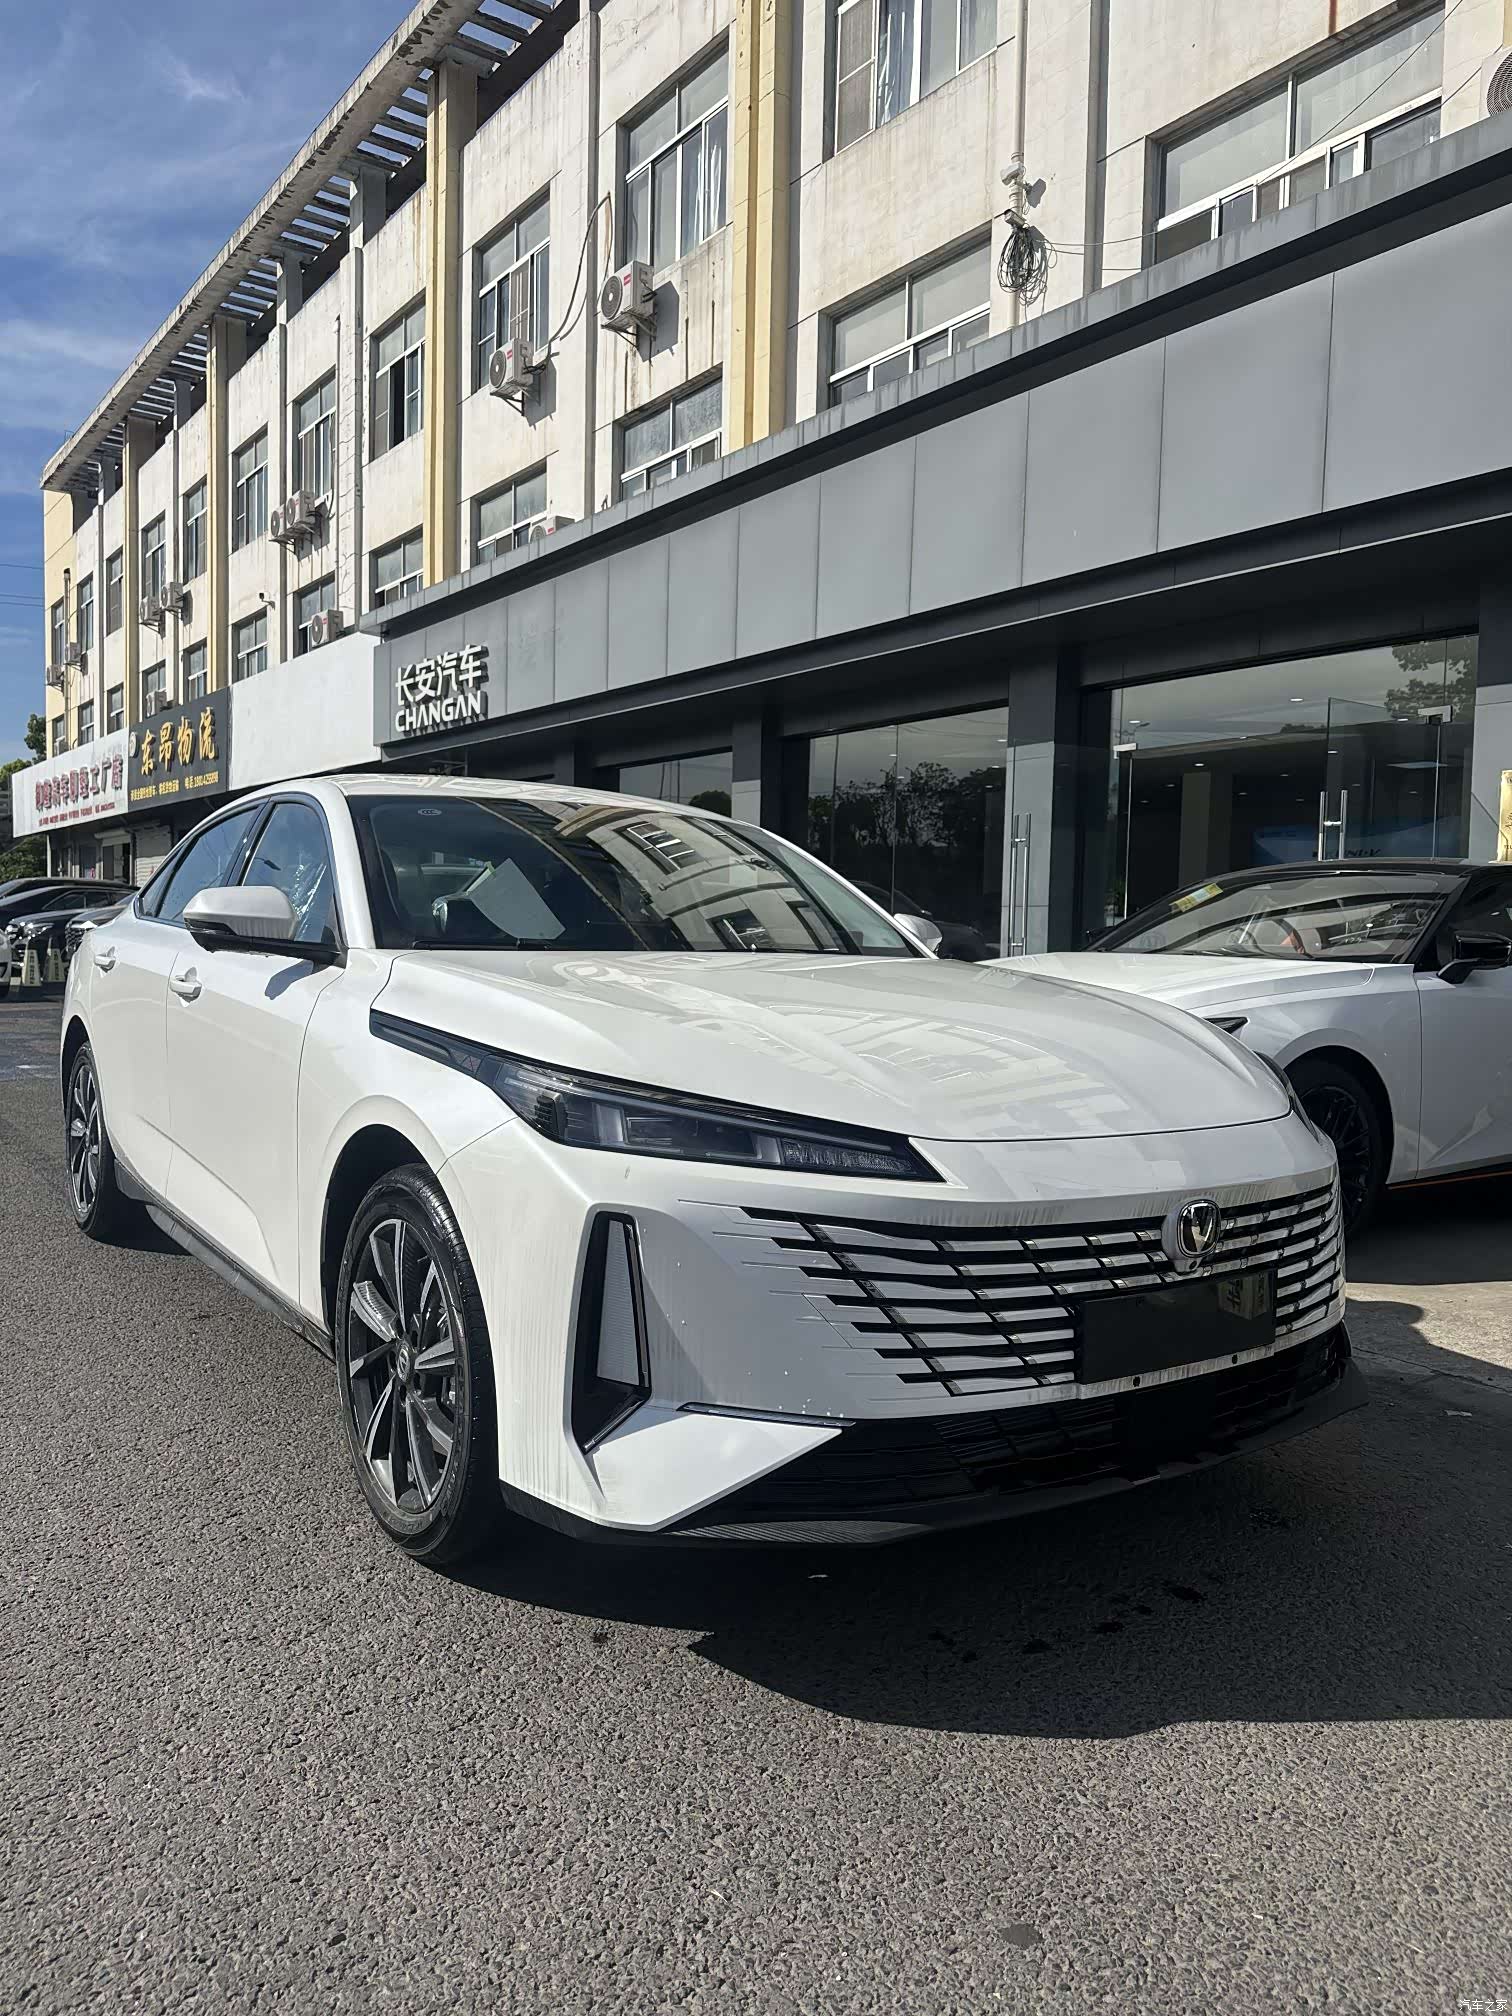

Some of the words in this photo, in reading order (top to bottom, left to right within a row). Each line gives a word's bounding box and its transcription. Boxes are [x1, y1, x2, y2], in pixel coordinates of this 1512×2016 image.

[395, 644, 482, 706] 长安汽车
[395, 690, 481, 732] CHANGAN
